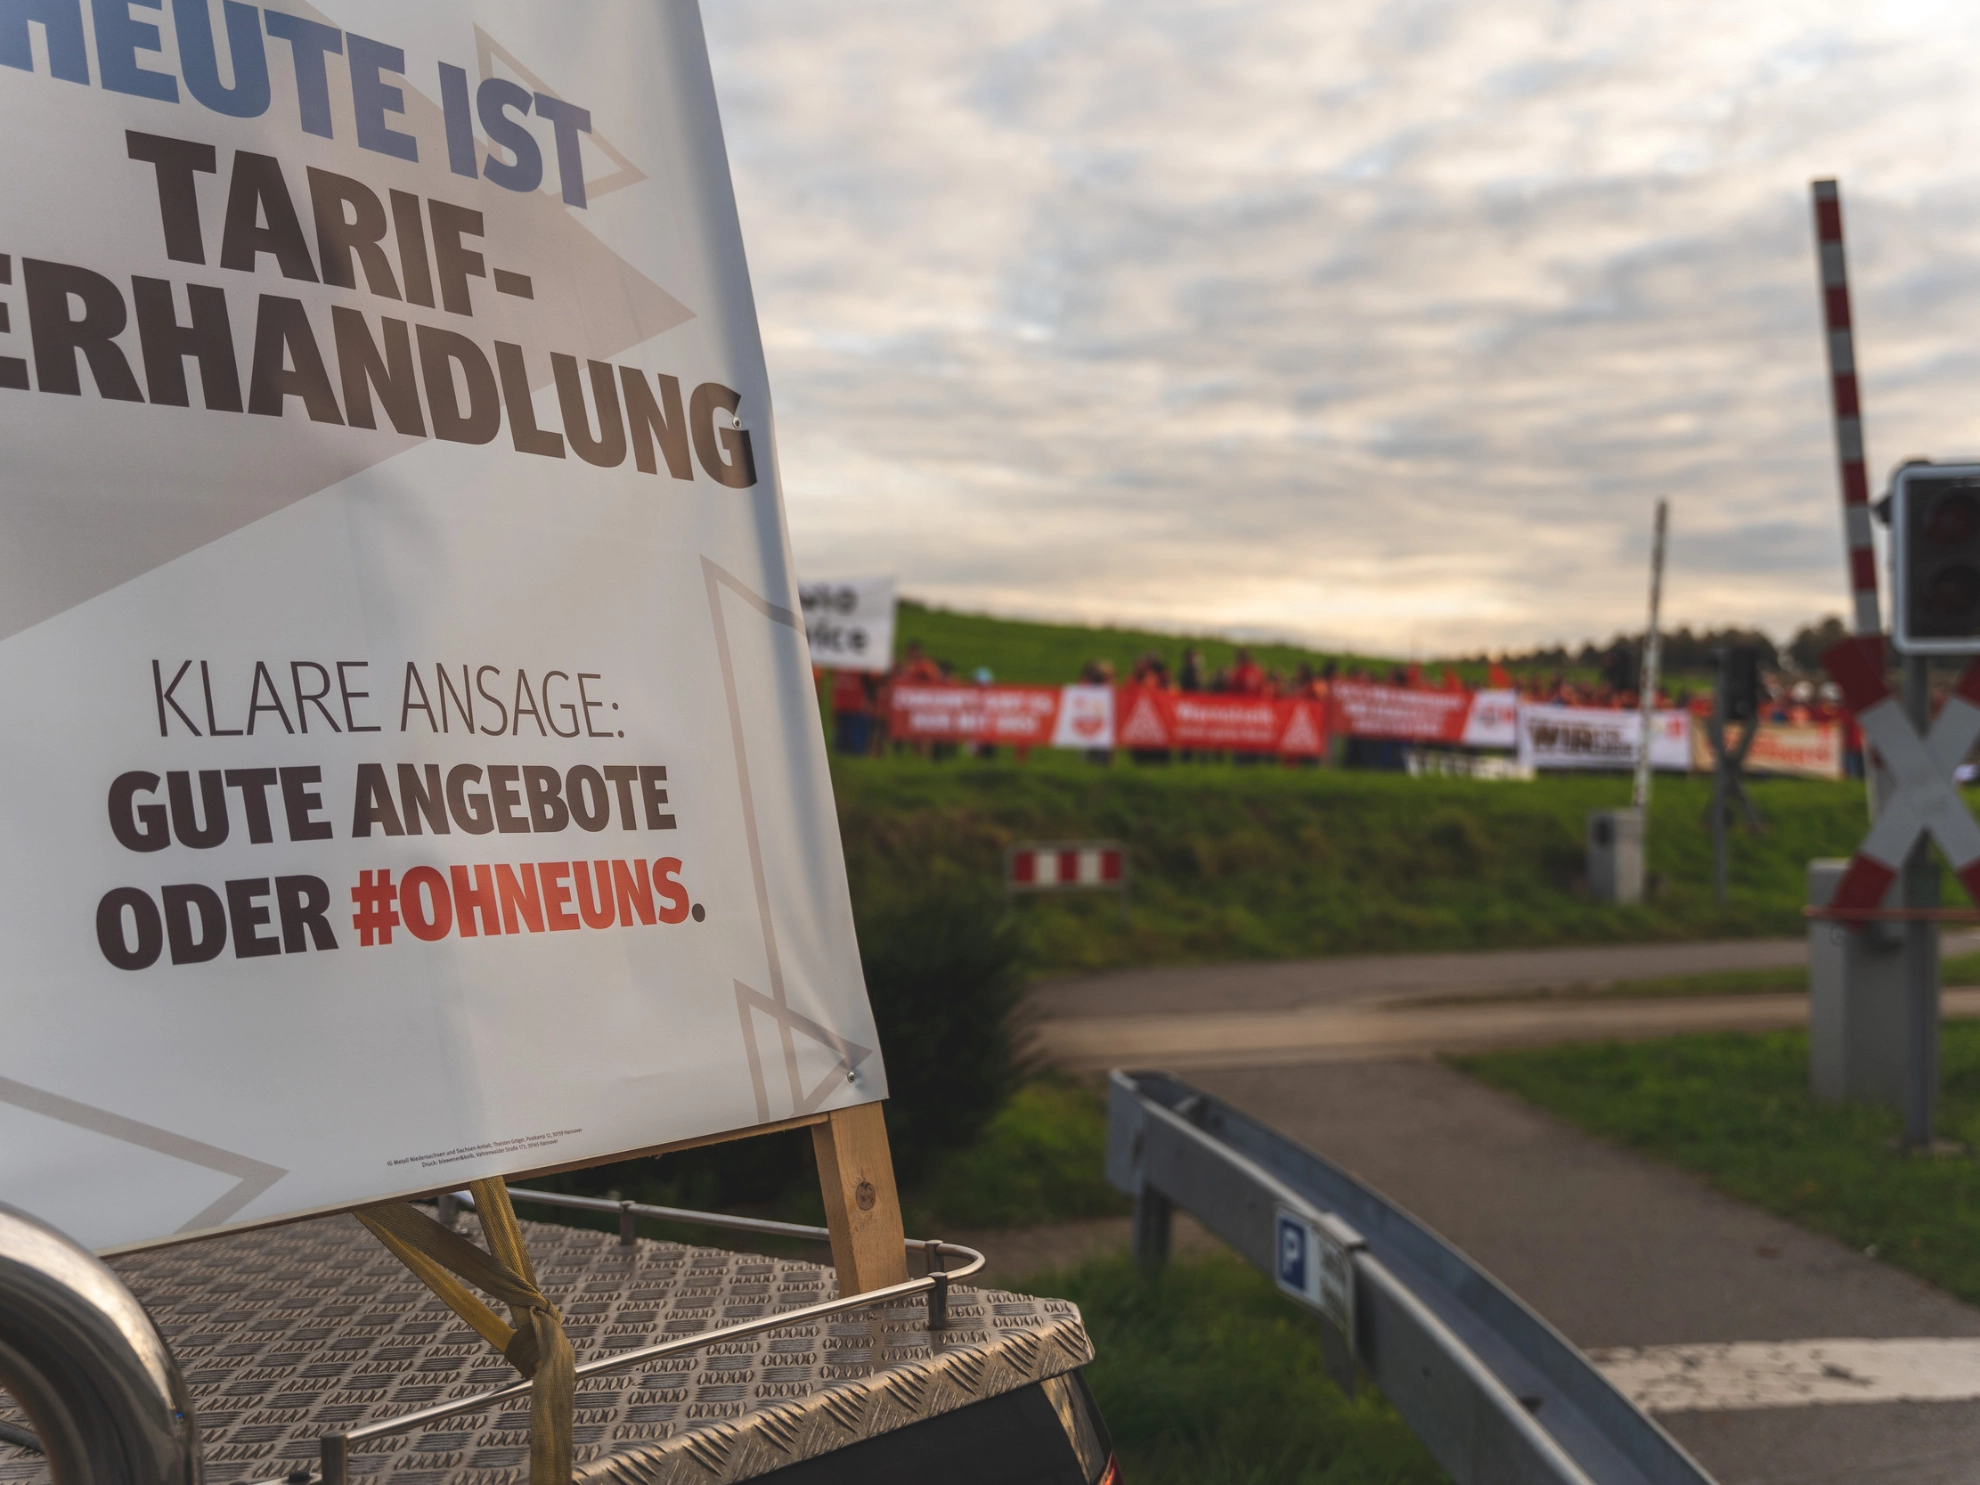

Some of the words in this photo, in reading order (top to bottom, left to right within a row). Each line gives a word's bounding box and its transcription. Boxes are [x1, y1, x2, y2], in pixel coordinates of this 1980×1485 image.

[0, 0, 419, 163] HEUTE
[437, 60, 592, 210] IST
[125, 129, 534, 317] TARIF-
[152, 659, 381, 737] KLARE
[401, 661, 626, 738] ANSAGE:
[107, 764, 333, 853] GUTE
[351, 763, 677, 838] ANGEBOTE
[96, 874, 339, 971] ODER
[351, 856, 706, 947] #OHNEUNS.
[393, 1157, 410, 1166] Metall
[410, 1151, 446, 1163] Niedersachsen
[493, 1139, 511, 1148] Thorsten
[564, 1127, 583, 1135] Hannover
[422, 1159, 438, 1168] Druck:
[540, 1139, 558, 1147] Hannover
[1282, 1227, 1300, 1271] P
